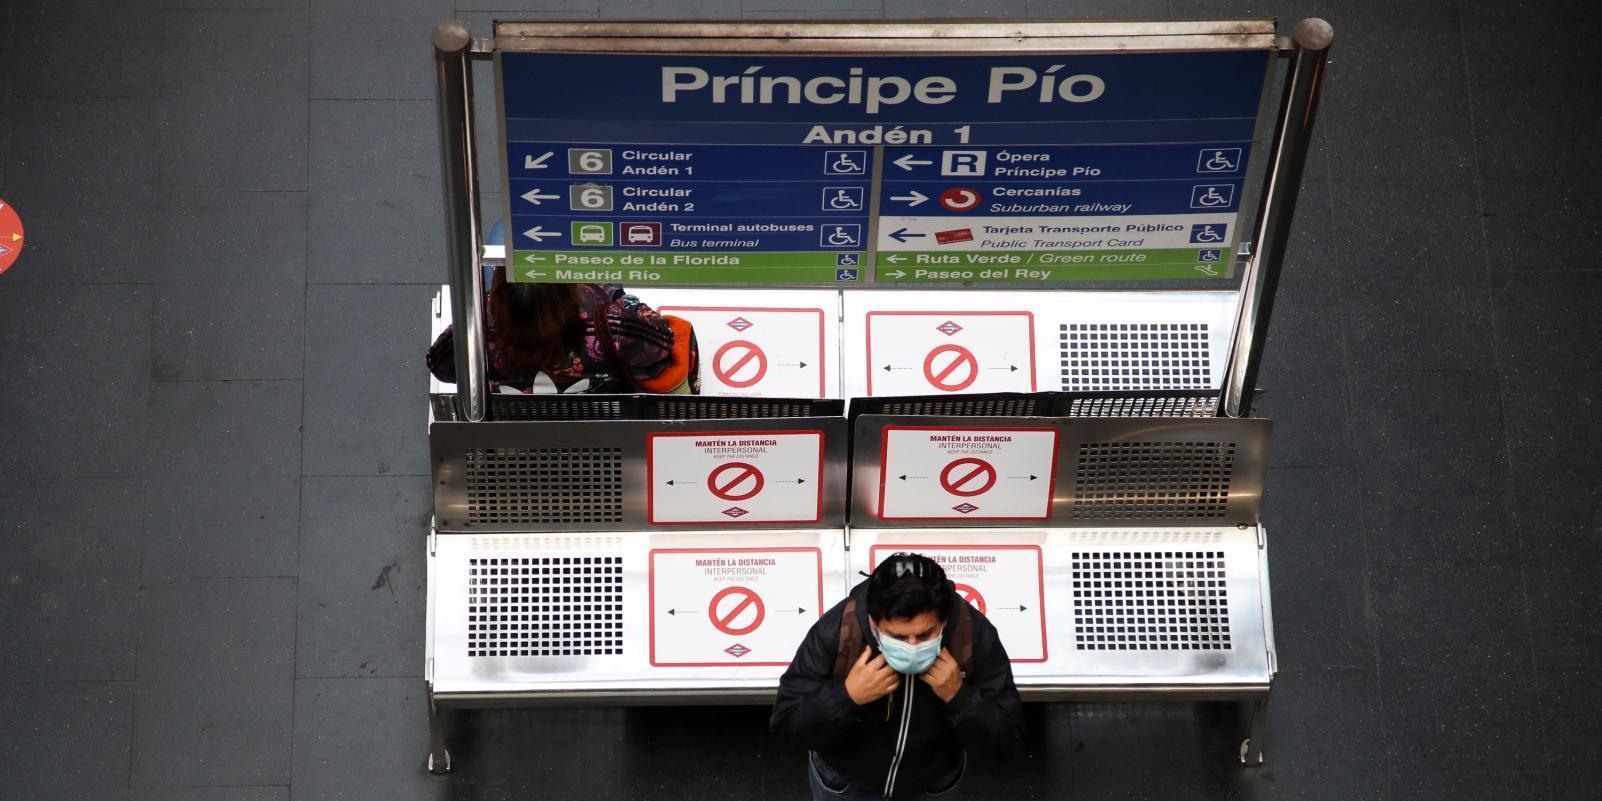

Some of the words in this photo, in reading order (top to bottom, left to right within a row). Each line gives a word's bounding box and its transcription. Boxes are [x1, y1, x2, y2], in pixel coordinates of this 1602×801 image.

[662, 66, 956, 113] Príncipe
[988, 64, 1105, 103] Pío
[802, 125, 933, 144] Andén
[954, 126, 970, 143] 1
[579, 152, 603, 171] 6
[622, 151, 692, 161] Circular
[996, 151, 1050, 164] Ópera
[951, 154, 977, 172] R
[622, 165, 678, 175] Andén
[686, 166, 693, 175] 1
[995, 166, 1067, 178] Príncipe
[1074, 165, 1101, 176] Pío
[623, 187, 692, 198] Circular
[993, 186, 1081, 197] Cercanías
[580, 188, 604, 208] 6
[622, 201, 678, 212] Andén
[684, 202, 694, 211] 2
[990, 203, 1070, 213] Suburban
[1074, 202, 1131, 214] railway
[671, 223, 733, 232] Terminal
[737, 223, 814, 232] autobuses
[983, 225, 1035, 236] Tarjeta
[1039, 224, 1121, 236] Transporte
[1125, 223, 1183, 234] Público
[670, 239, 697, 248] Bus
[702, 238, 759, 248] terminal
[981, 240, 1029, 249] Public
[1033, 239, 1103, 249] Transport
[1107, 238, 1144, 248] Card
[555, 254, 614, 265] Paseo
[620, 254, 644, 265] de
[650, 254, 667, 265] la
[674, 254, 740, 265] Florida
[916, 253, 959, 264] Ruta
[965, 253, 1021, 264] Verde
[1040, 253, 1094, 263] Green
[1099, 252, 1147, 263] route
[555, 270, 621, 280] Madrid
[628, 270, 660, 280] Río
[915, 269, 974, 280] Paseo
[980, 269, 1012, 279] del
[1015, 269, 1051, 280] Rey
[696, 558, 725, 566] MANTÉN
